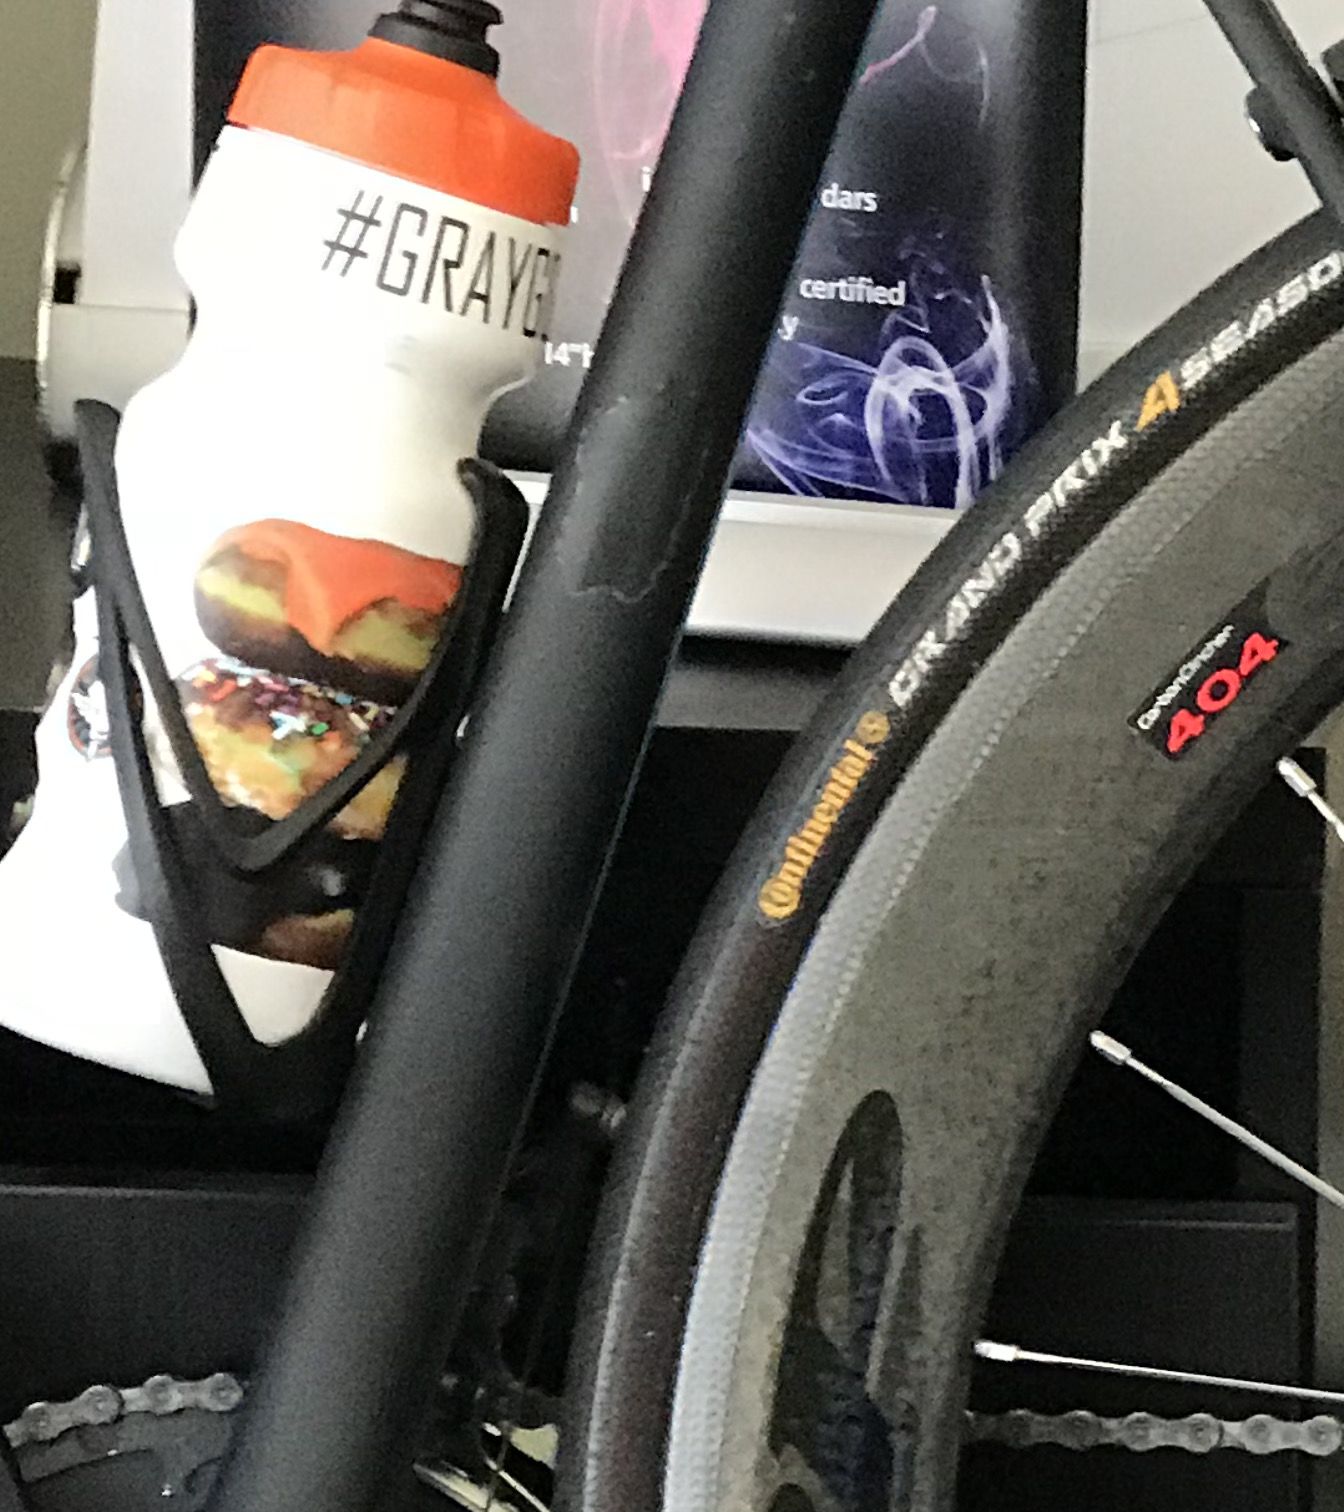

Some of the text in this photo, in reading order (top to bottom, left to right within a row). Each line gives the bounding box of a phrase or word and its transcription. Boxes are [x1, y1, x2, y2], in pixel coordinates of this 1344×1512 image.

[800, 276, 906, 306] certified
[758, 739, 877, 918] Continental
[890, 533, 1021, 706] GRAND
[1025, 420, 1128, 537] PRIX
[1167, 632, 1279, 753] 404
